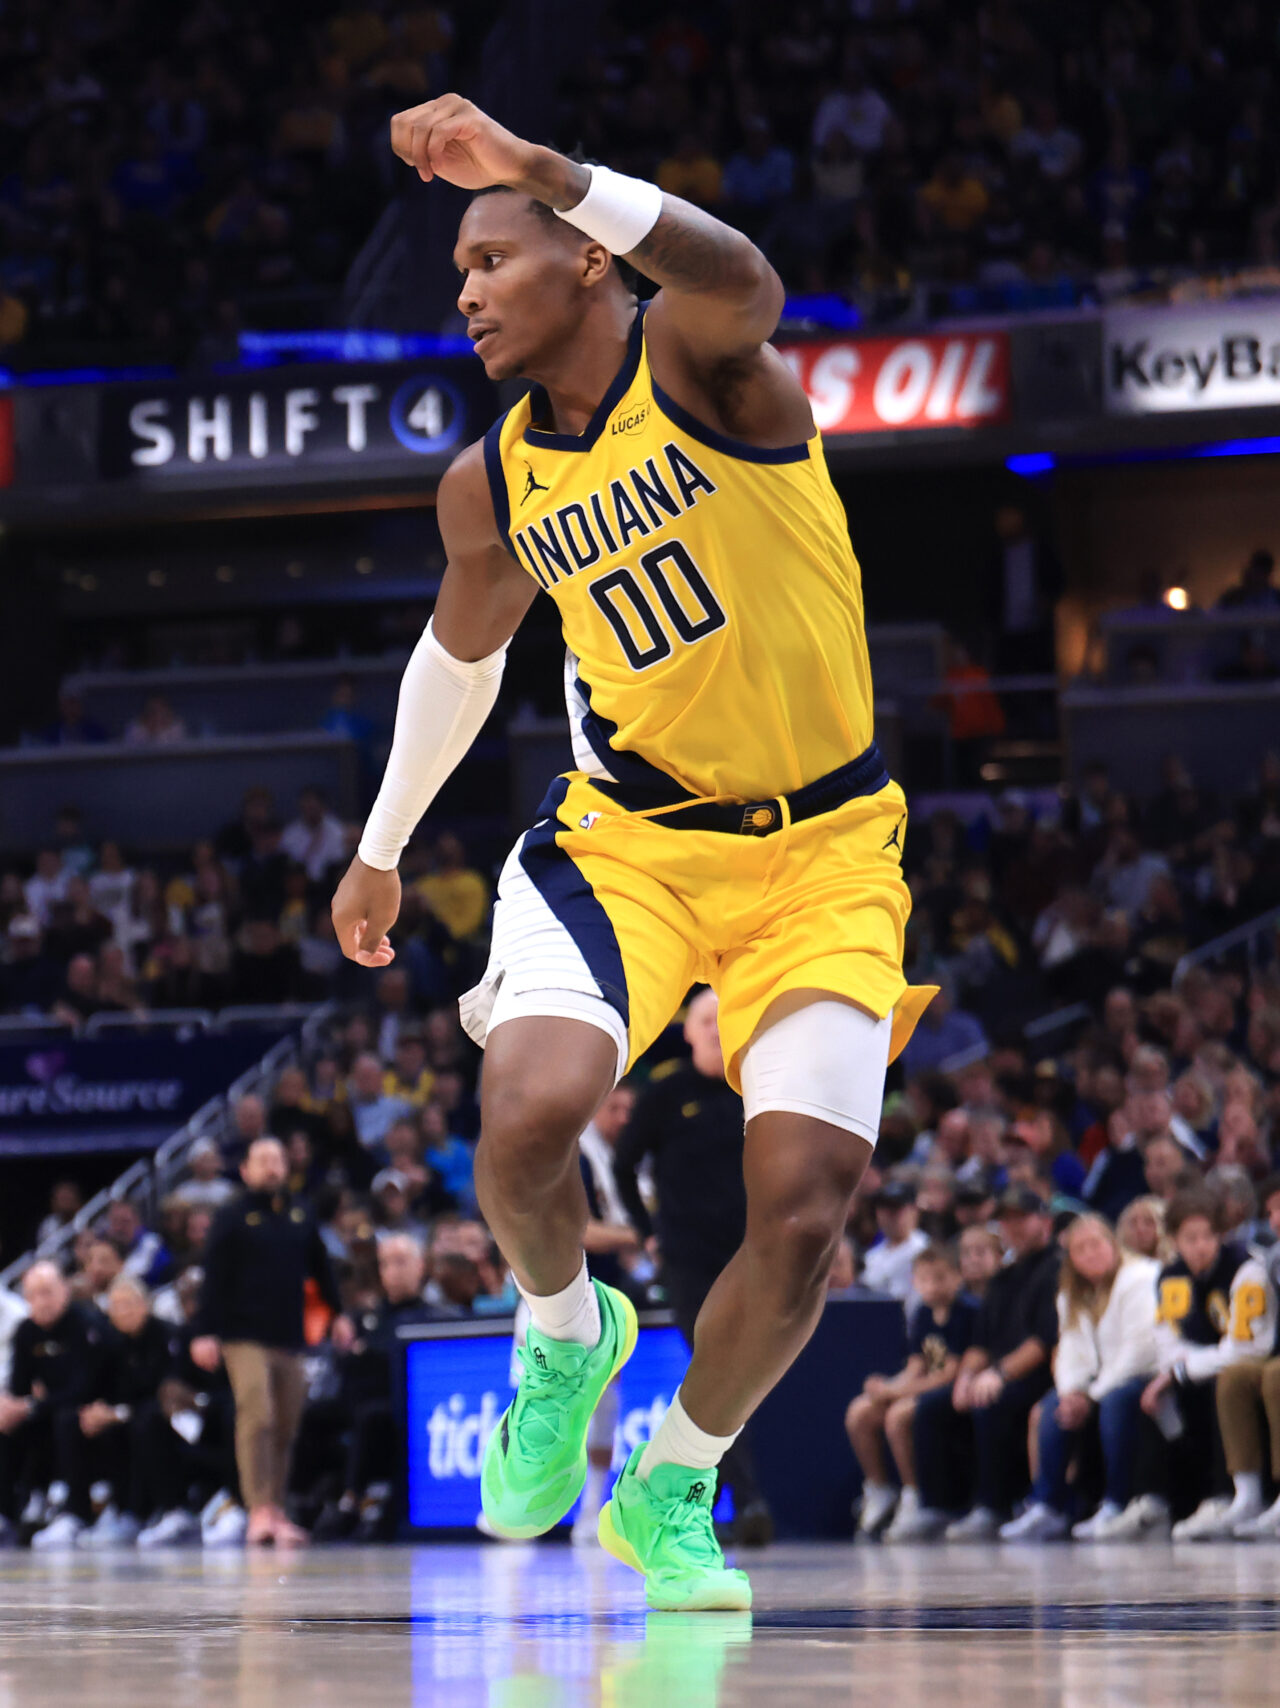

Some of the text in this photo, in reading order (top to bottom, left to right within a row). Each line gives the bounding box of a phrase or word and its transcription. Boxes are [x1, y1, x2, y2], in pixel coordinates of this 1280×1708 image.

[129, 383, 380, 467] SHIFT
[612, 409, 645, 436] LUCAS
[784, 338, 999, 430] S OIL
[516, 442, 717, 590] INDIANA
[588, 539, 728, 672] 00
